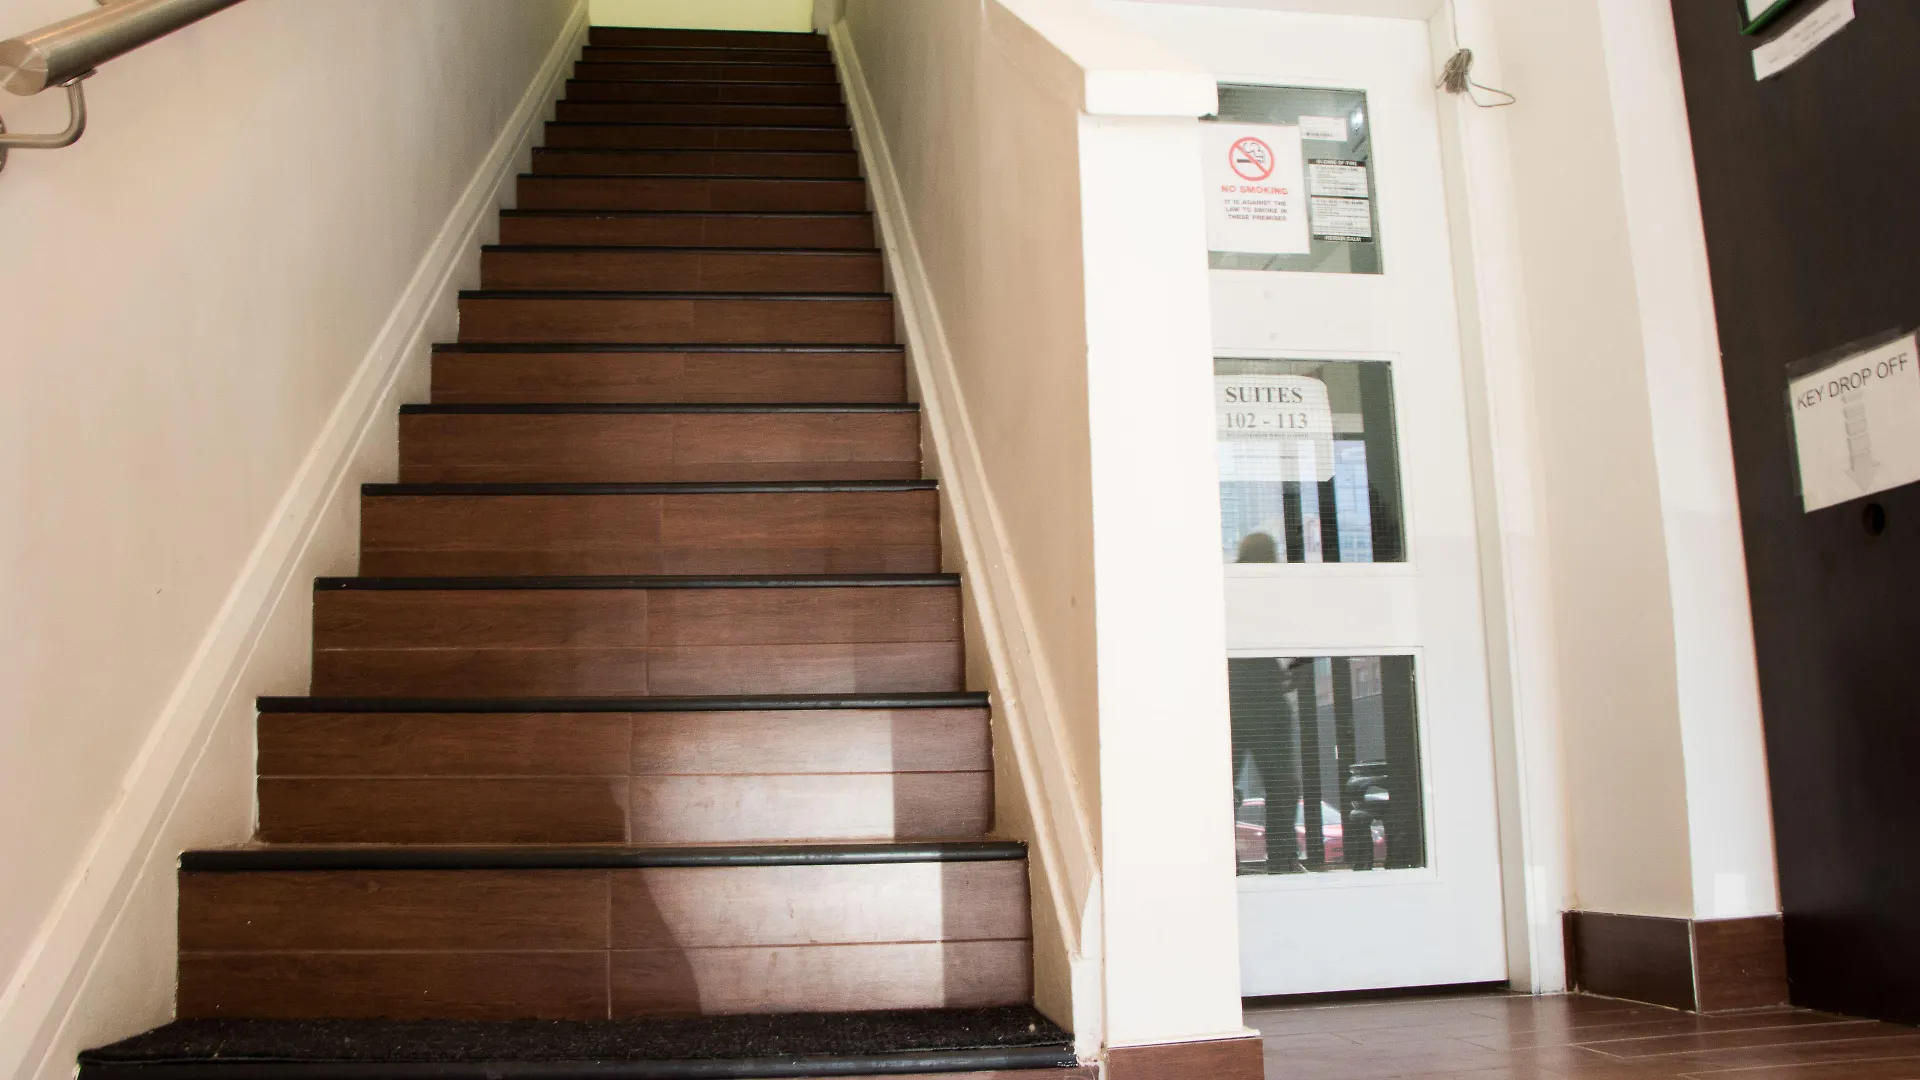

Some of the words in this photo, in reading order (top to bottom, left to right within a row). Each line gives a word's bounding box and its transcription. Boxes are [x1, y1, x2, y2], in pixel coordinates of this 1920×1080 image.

[1221, 185, 1236, 193] NO
[1240, 186, 1288, 195] SMOKING
[1796, 385, 1825, 410] KEY
[1828, 368, 1872, 398] DROP
[1876, 353, 1908, 378] OFF
[1225, 386, 1304, 404] SUITES
[1226, 412, 1257, 429] 102
[1277, 412, 1308, 429] 113
